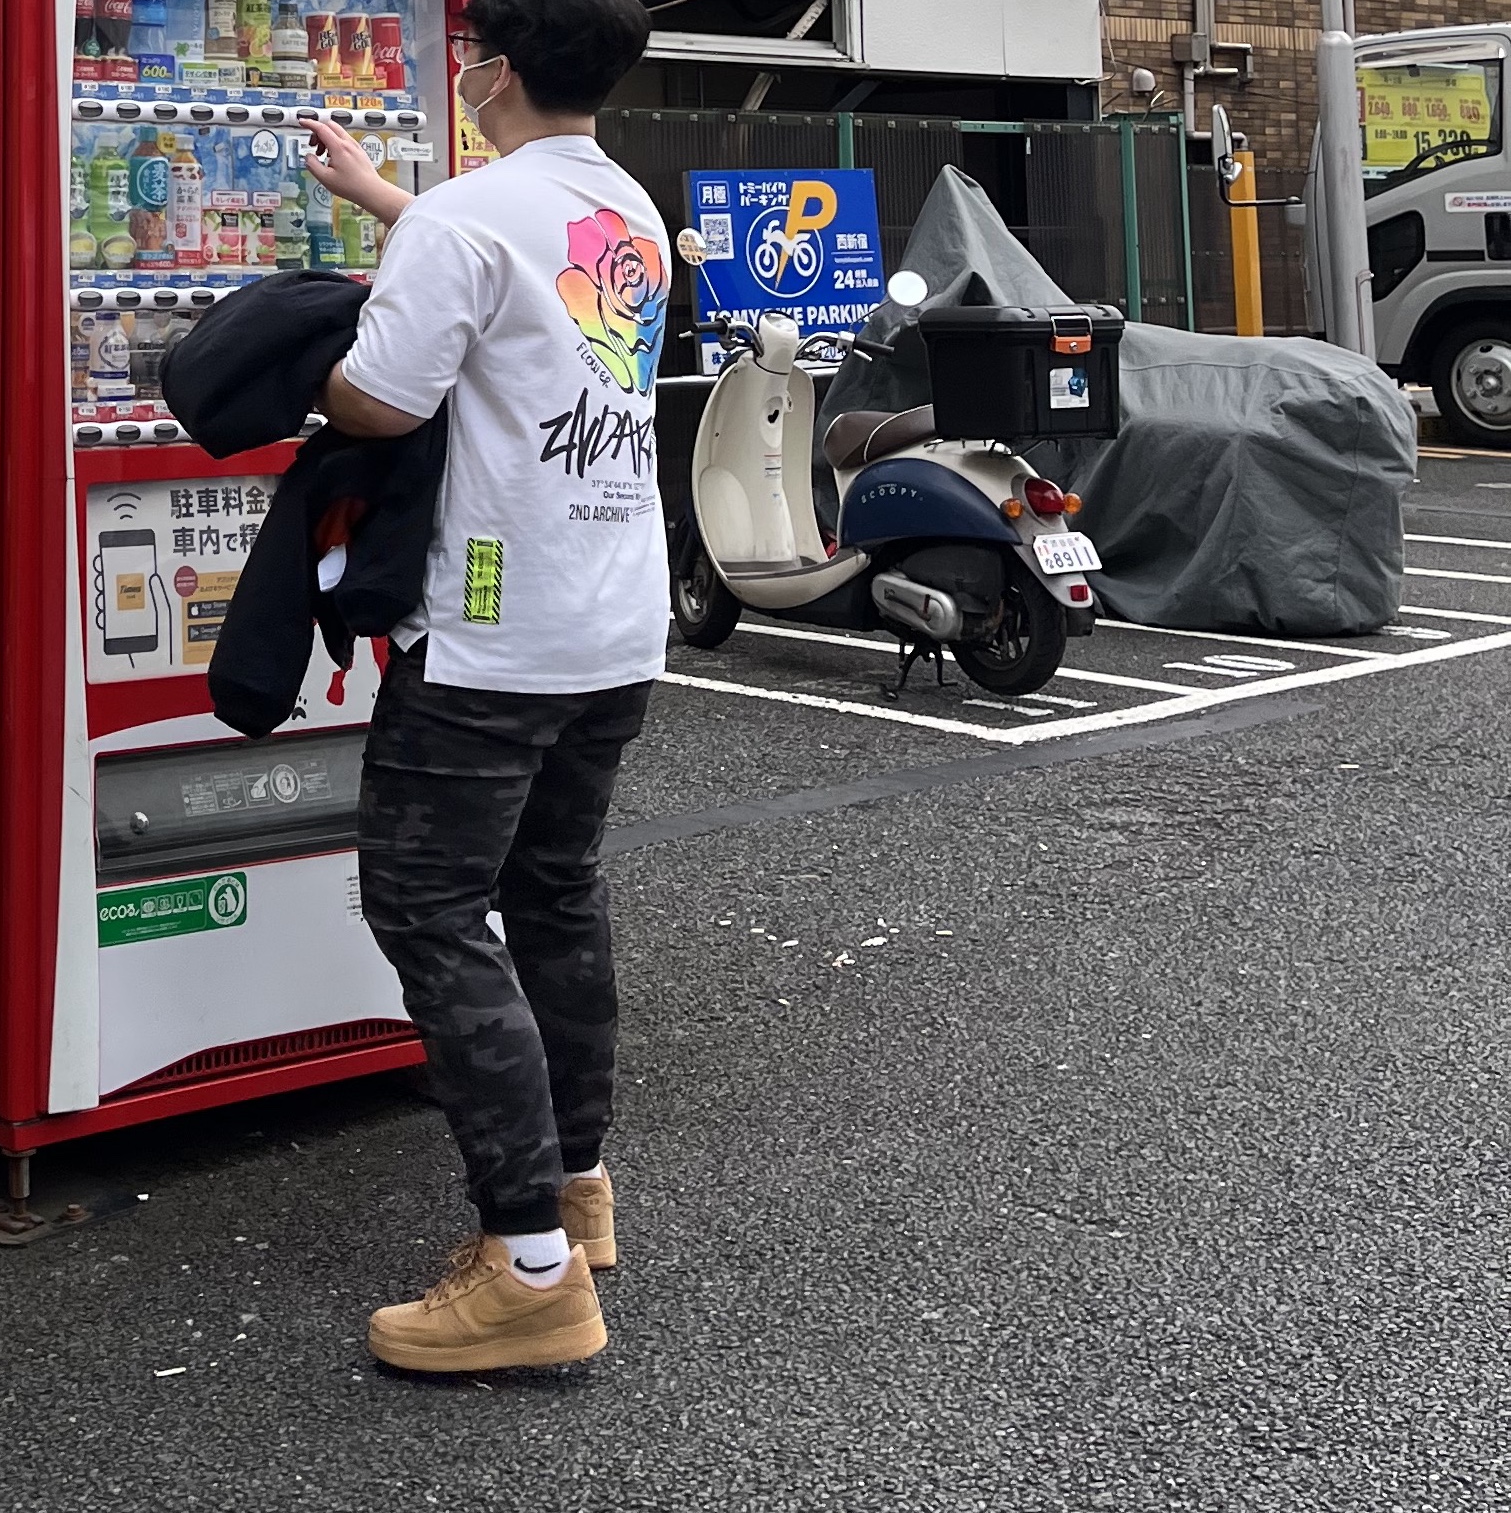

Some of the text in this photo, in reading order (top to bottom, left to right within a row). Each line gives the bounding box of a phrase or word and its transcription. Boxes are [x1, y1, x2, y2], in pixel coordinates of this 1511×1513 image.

[1413, 129, 1472, 156] 15330
[702, 185, 727, 204] 月極
[785, 180, 838, 240] P
[835, 233, 869, 250] 西新宿
[833, 269, 855, 289] 24
[706, 310, 761, 327] TOMY
[861, 487, 918, 504] SCOOPY
[568, 504, 631, 524] 2ND ARCHIVE
[1053, 546, 1094, 568] 8911
